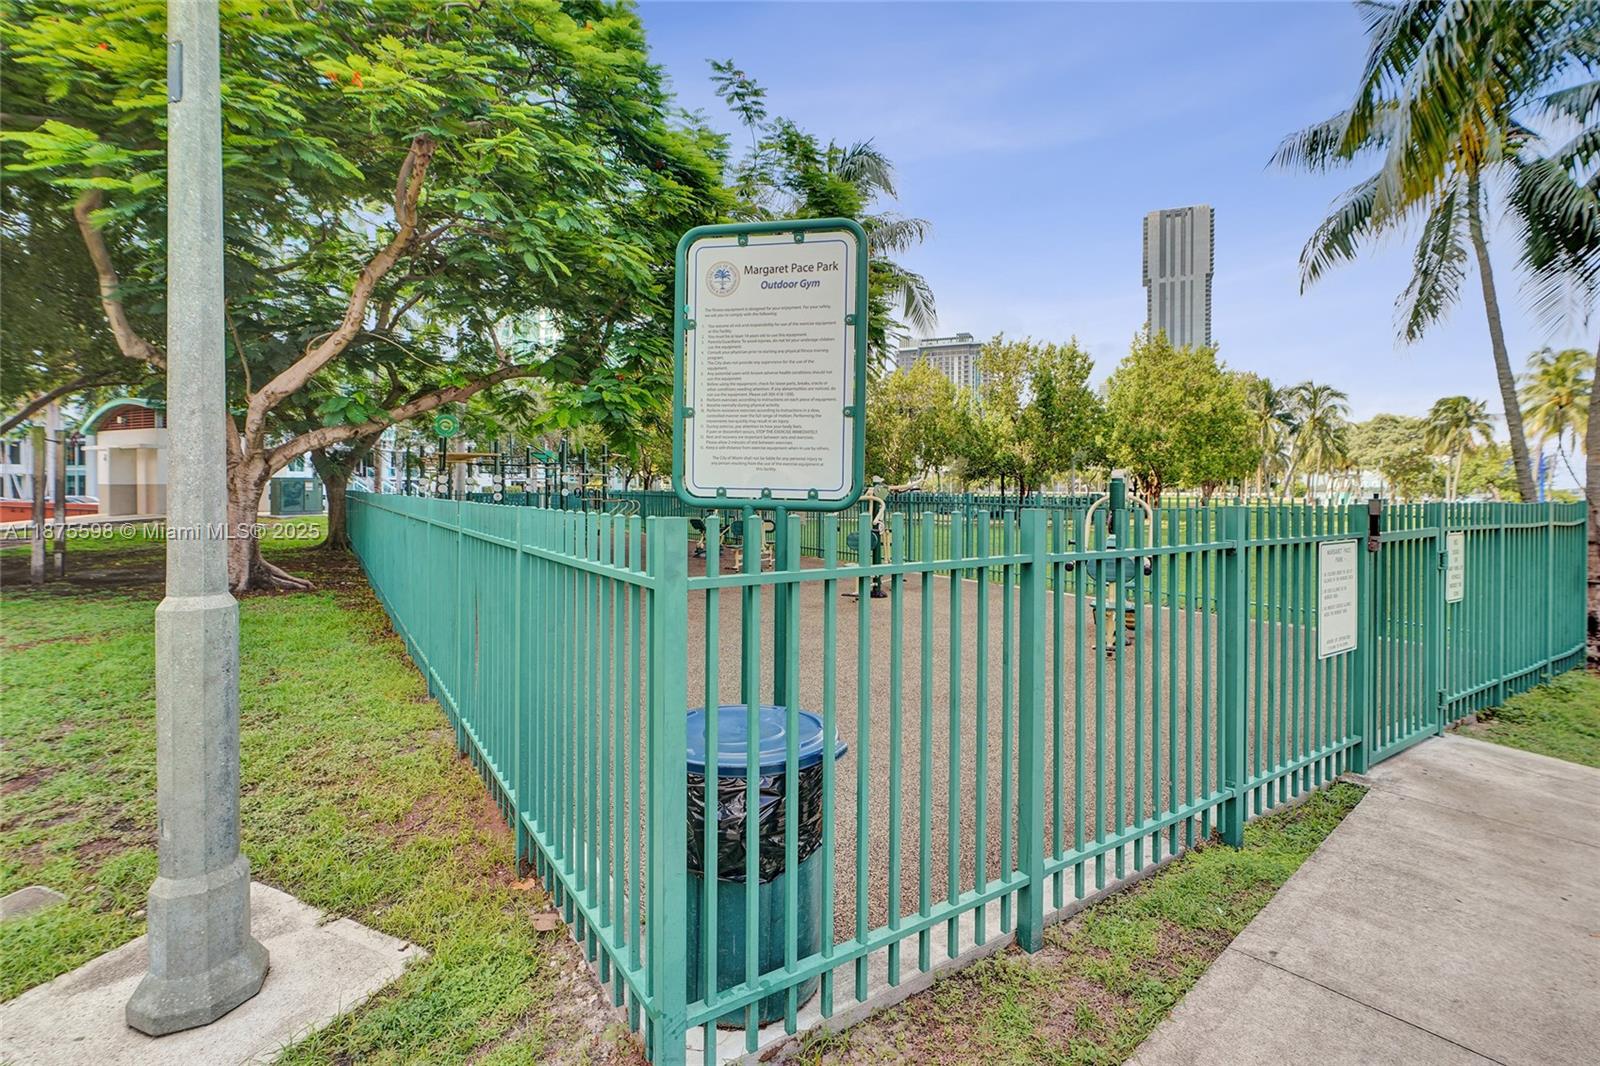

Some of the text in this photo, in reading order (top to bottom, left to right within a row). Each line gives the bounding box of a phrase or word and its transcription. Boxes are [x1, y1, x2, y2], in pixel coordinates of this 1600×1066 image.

[744, 261, 838, 277] Margaret Pace Park
[760, 279, 820, 290] Outdoor Gym
